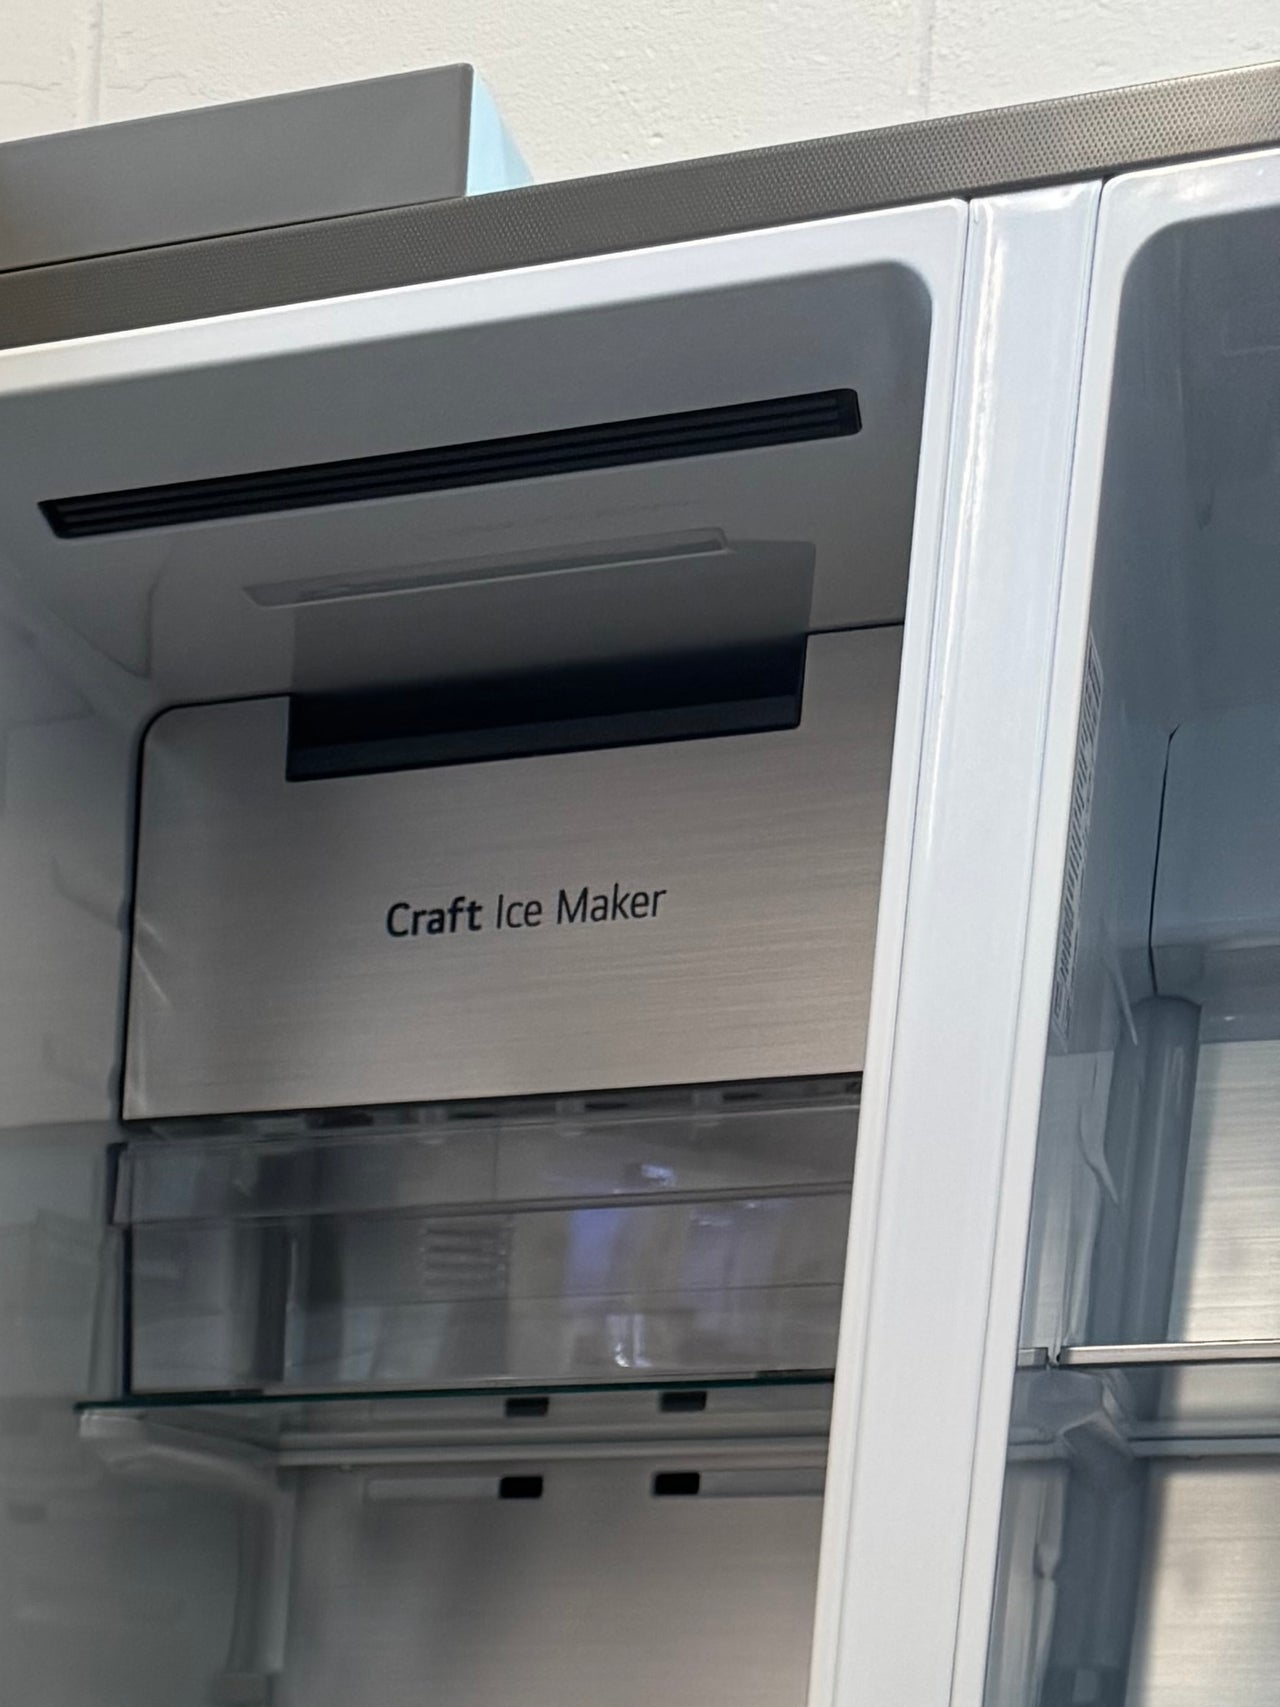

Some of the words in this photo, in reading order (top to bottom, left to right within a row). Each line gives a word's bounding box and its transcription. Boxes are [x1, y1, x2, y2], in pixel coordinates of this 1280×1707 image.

[386, 896, 482, 937] Craft
[496, 894, 542, 929] Ice
[557, 883, 668, 925] Maker
